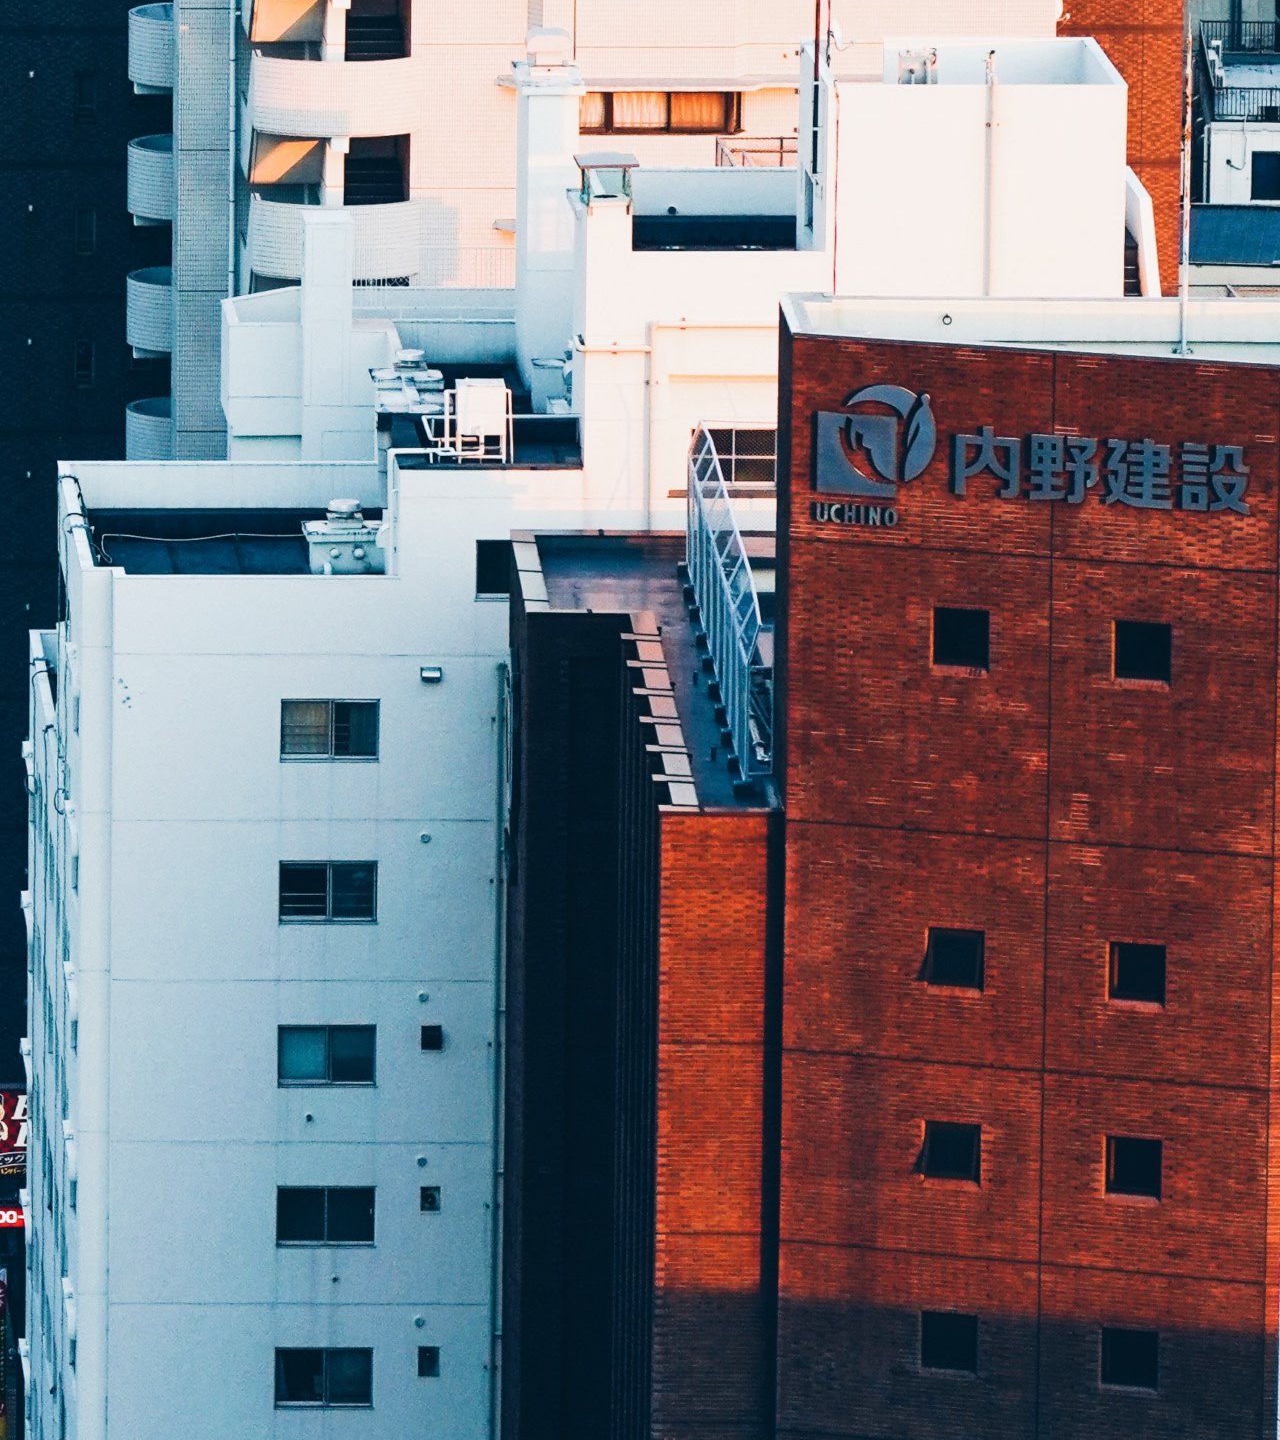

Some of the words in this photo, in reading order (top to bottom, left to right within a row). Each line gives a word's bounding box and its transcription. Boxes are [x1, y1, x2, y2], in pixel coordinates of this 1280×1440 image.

[954, 426, 1251, 516] 内野建設
[815, 503, 899, 527] UCHINO
